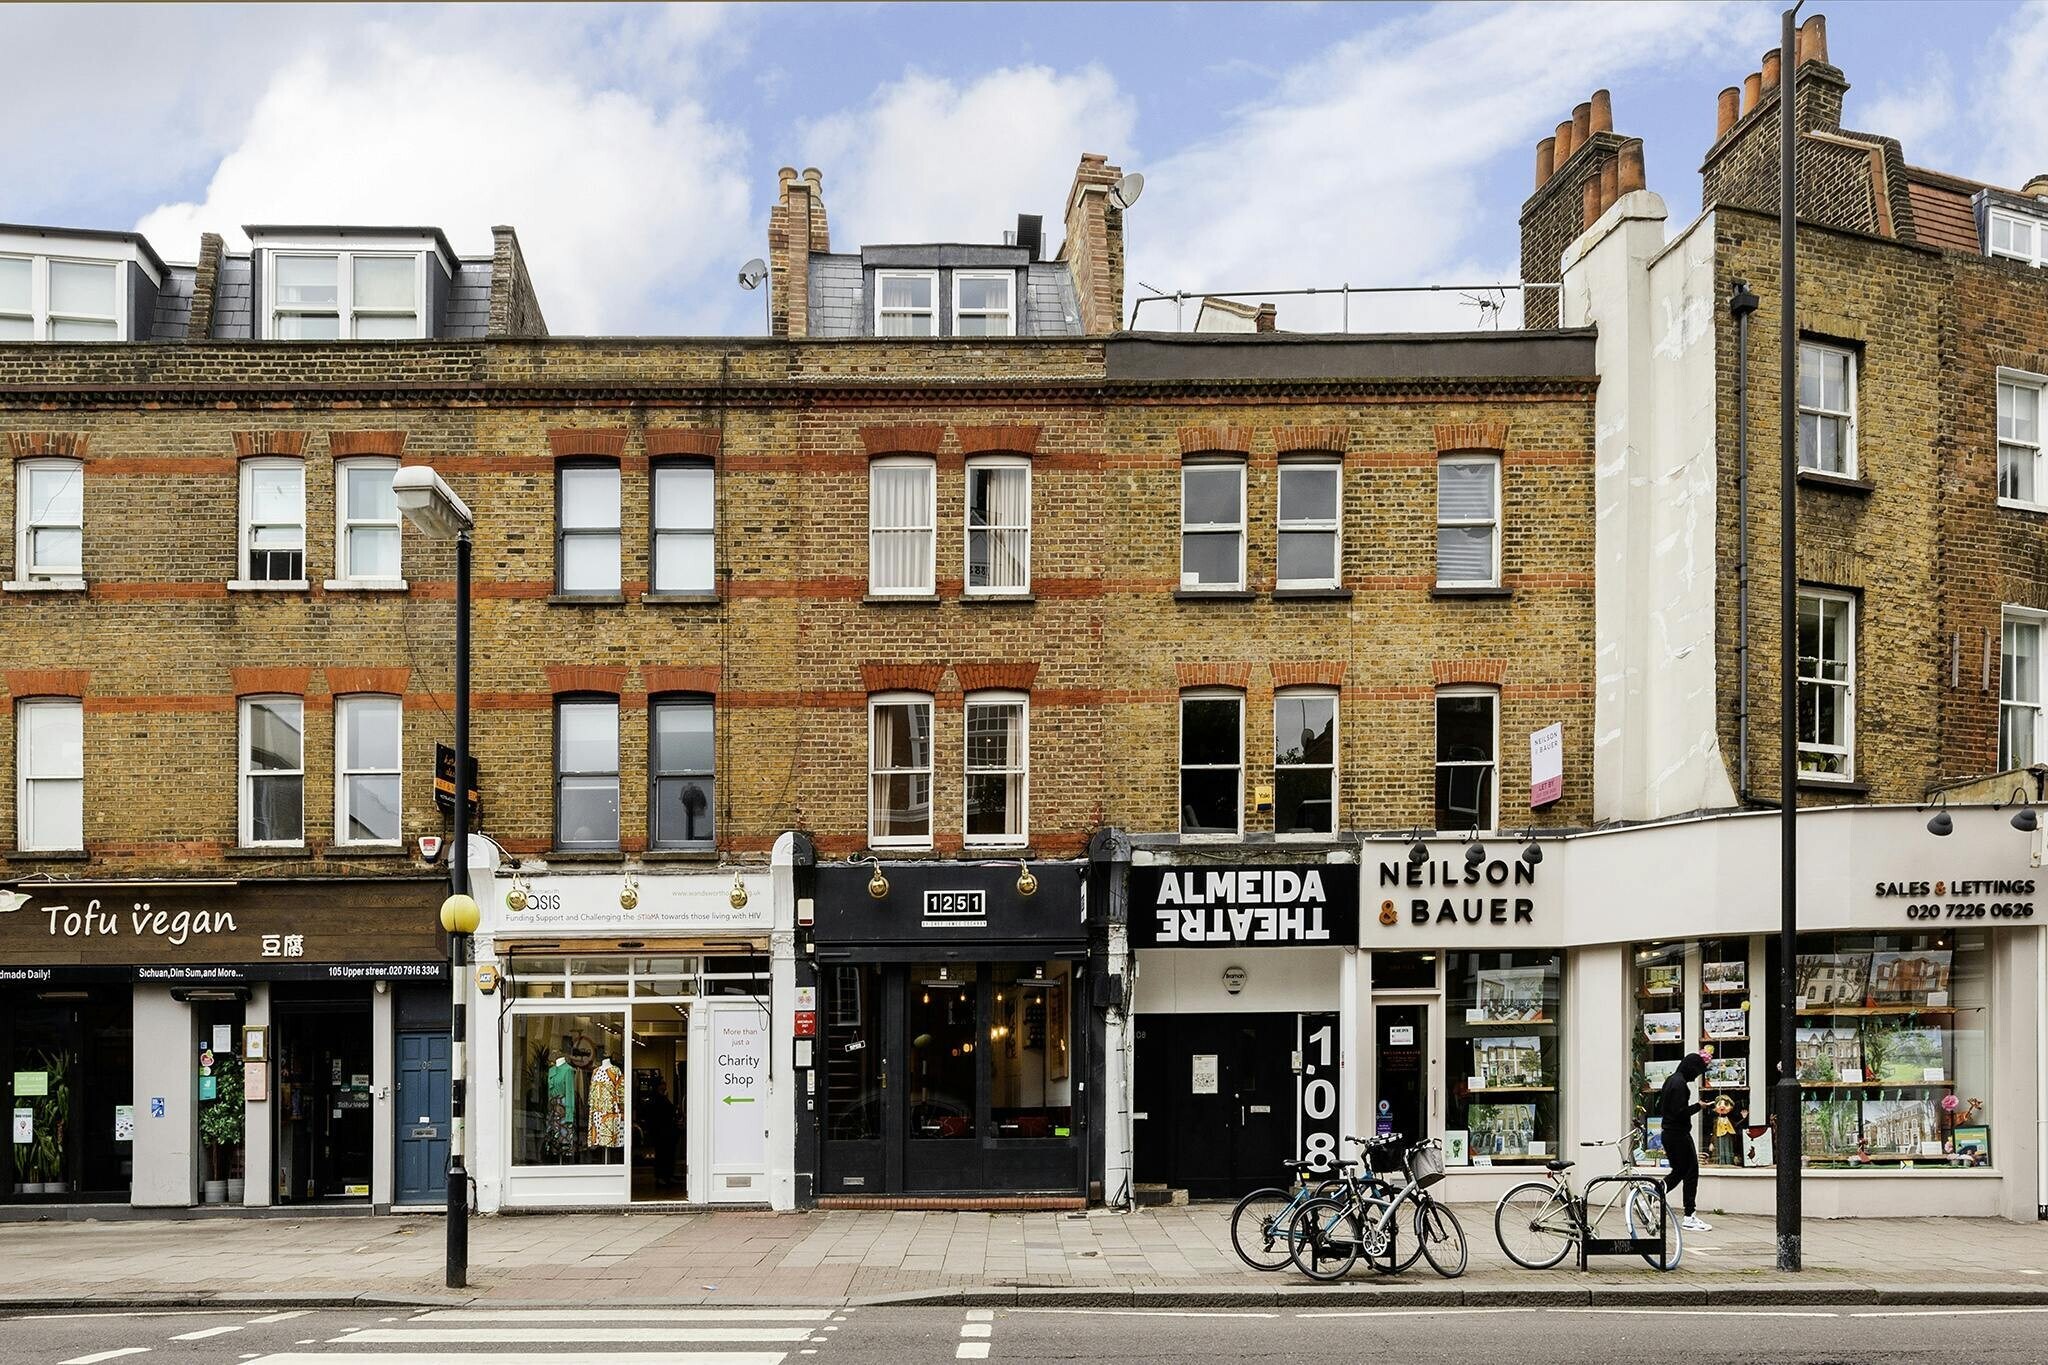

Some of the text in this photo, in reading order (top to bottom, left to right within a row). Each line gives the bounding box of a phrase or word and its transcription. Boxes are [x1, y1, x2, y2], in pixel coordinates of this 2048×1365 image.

[1534, 732, 1558, 745] NEILSON
[1540, 740, 1558, 753] BAUER
[1538, 783, 1547, 791] LET
[1380, 860, 1535, 887] NEILSON
[1156, 870, 1327, 904] ALMEIDA
[1875, 880, 2036, 897] SALES & LETTINGS
[931, 895, 979, 910] 1251
[41, 899, 118, 936] Tofu
[506, 914, 534, 923] Funding
[536, 913, 564, 923] Support
[581, 912, 620, 923] Challenging
[712, 912, 731, 921] living
[732, 912, 747, 920] with
[1379, 899, 1534, 926] & BAUER
[1907, 903, 2034, 919] 020 7226 0626
[1156, 907, 1330, 942] THEATRE
[261, 934, 304, 957] 豆腐
[27, 969, 51, 981] Daily!
[185, 967, 217, 979] Sum,and
[218, 967, 244, 978] More...
[329, 966, 342, 976] 105
[343, 966, 365, 978] Upper
[403, 965, 421, 975] 7916
[421, 965, 440, 975] 3304
[723, 1028, 741, 1036] More
[732, 1039, 744, 1047] just
[718, 1054, 760, 1069] Charity
[724, 1073, 754, 1088] Shop
